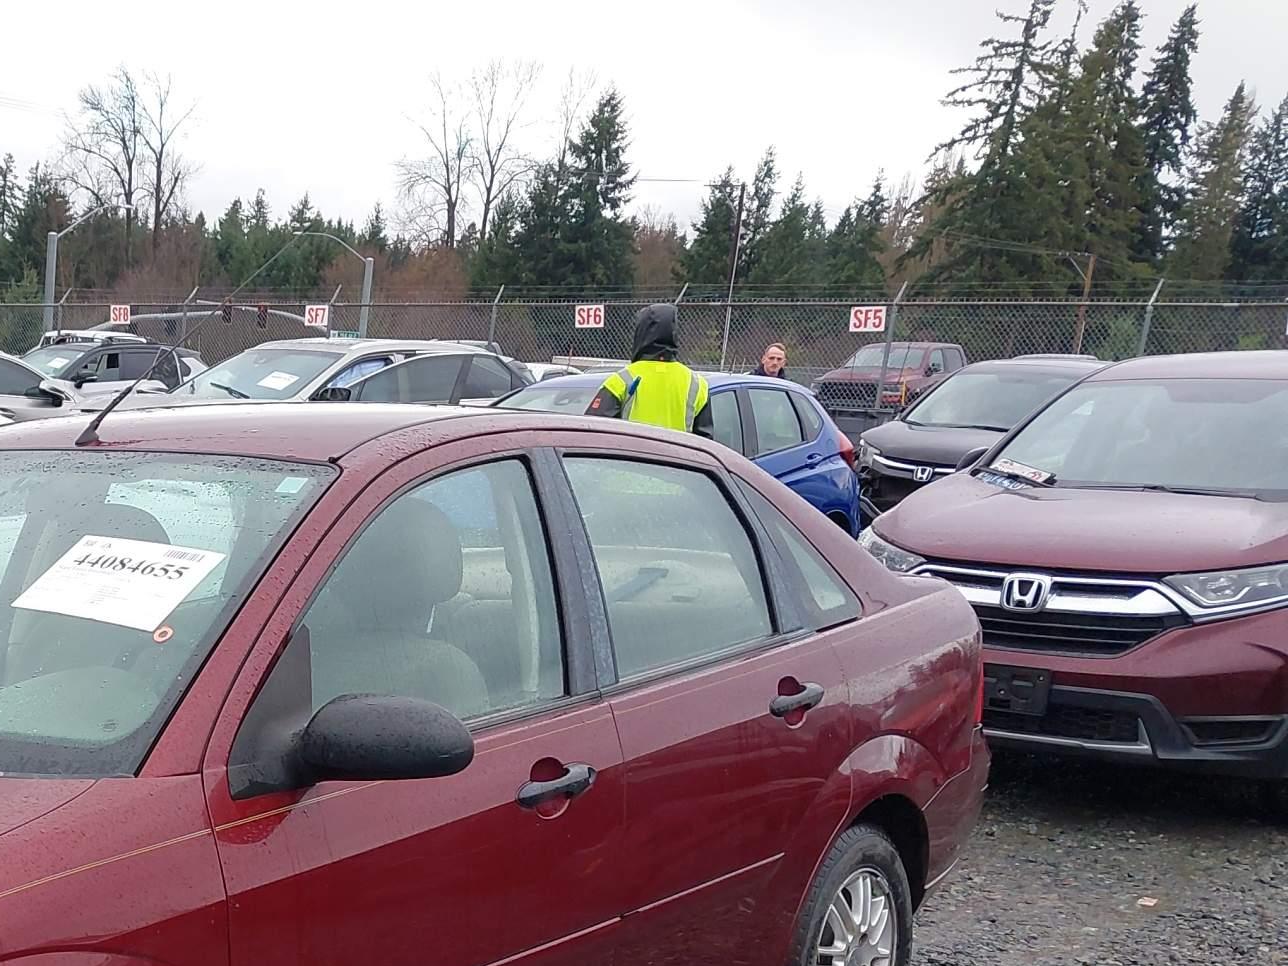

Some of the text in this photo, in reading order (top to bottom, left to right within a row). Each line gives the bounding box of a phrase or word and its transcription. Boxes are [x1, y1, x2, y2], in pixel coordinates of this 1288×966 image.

[112, 306, 129, 322] SF8
[307, 307, 327, 324] SF7
[577, 307, 602, 325] SF6
[853, 309, 883, 329] SF5
[73, 553, 191, 580] 44084655
